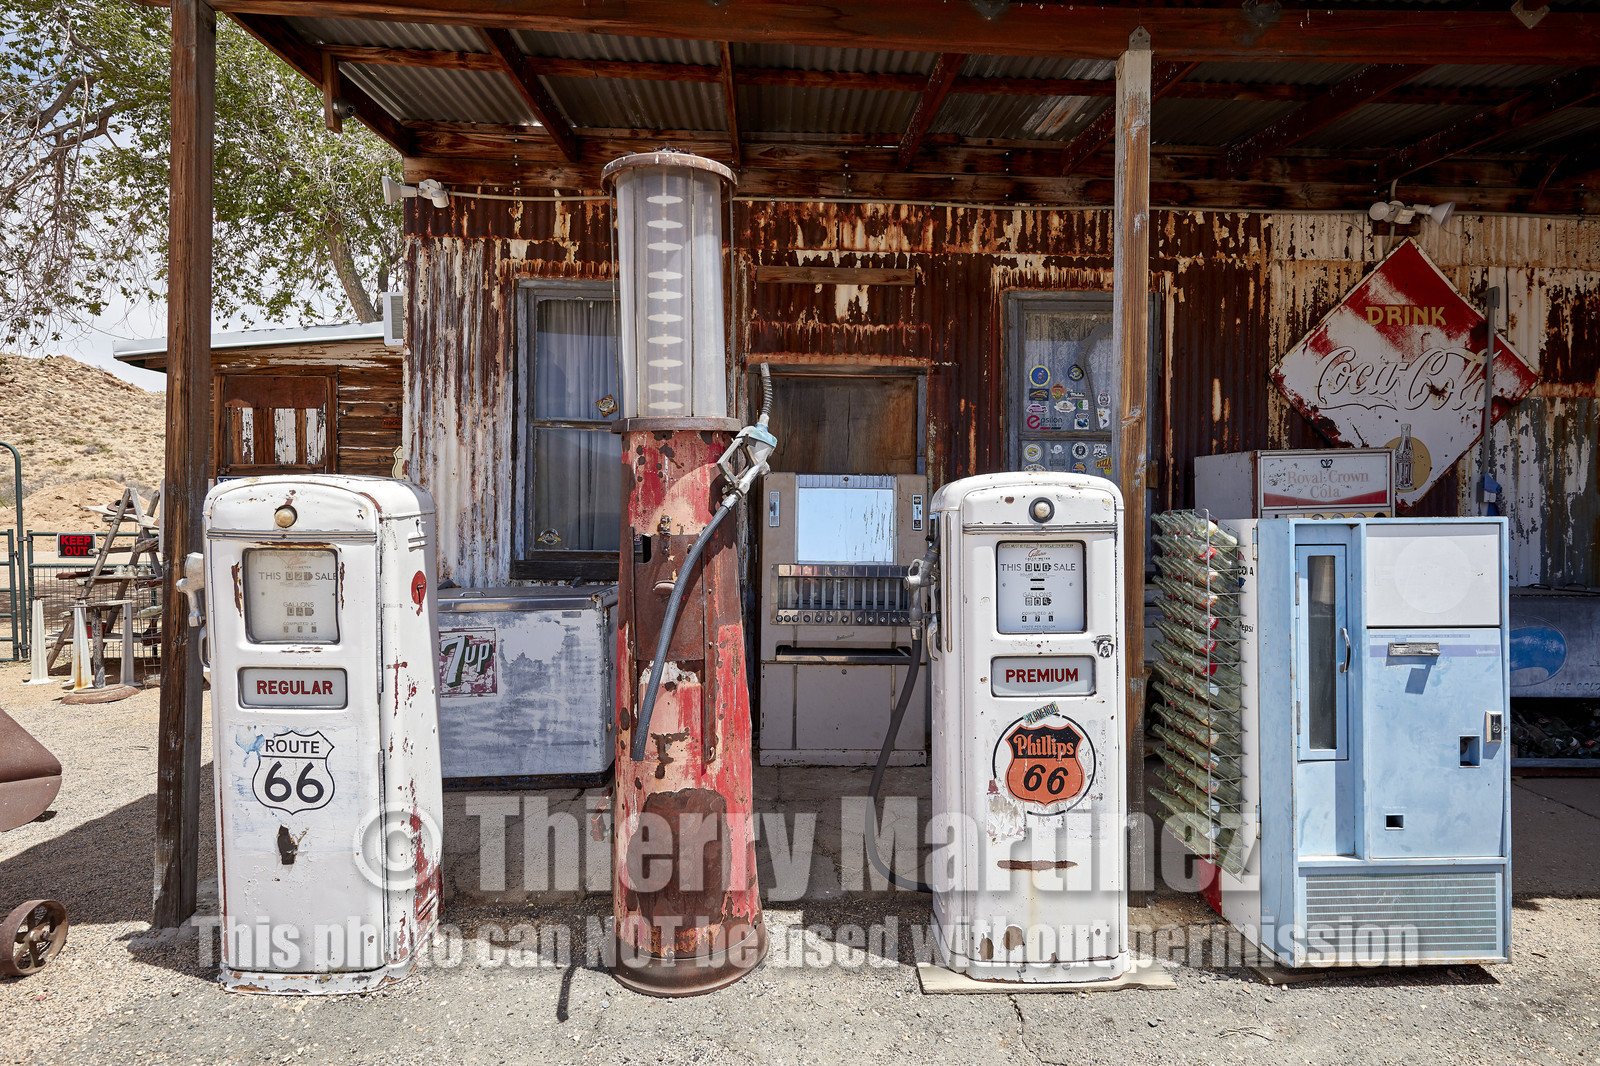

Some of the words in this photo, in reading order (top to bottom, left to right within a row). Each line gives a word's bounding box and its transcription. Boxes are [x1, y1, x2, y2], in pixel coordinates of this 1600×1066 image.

[1365, 306, 1447, 326] DRINK
[1316, 345, 1503, 412] Coca-Cola
[1027, 414, 1063, 429] epsilon
[1287, 470, 1328, 486] Royal
[1328, 470, 1369, 482] Crown
[1309, 485, 1341, 498] Cola
[60, 535, 92, 546] KEEP
[64, 546, 88, 556] OUT
[1000, 563, 1022, 571] THIS
[1053, 563, 1076, 571] SALE
[258, 571, 282, 581] THIS
[314, 572, 338, 581] SALE
[1238, 620, 1254, 633] Pepsi
[1005, 668, 1079, 683] PREMIUM
[256, 680, 334, 696] REGULAR
[264, 739, 320, 754] ROUTE
[1013, 733, 1075, 762] Phillips
[264, 760, 325, 804] 66
[1023, 764, 1069, 795] 66
